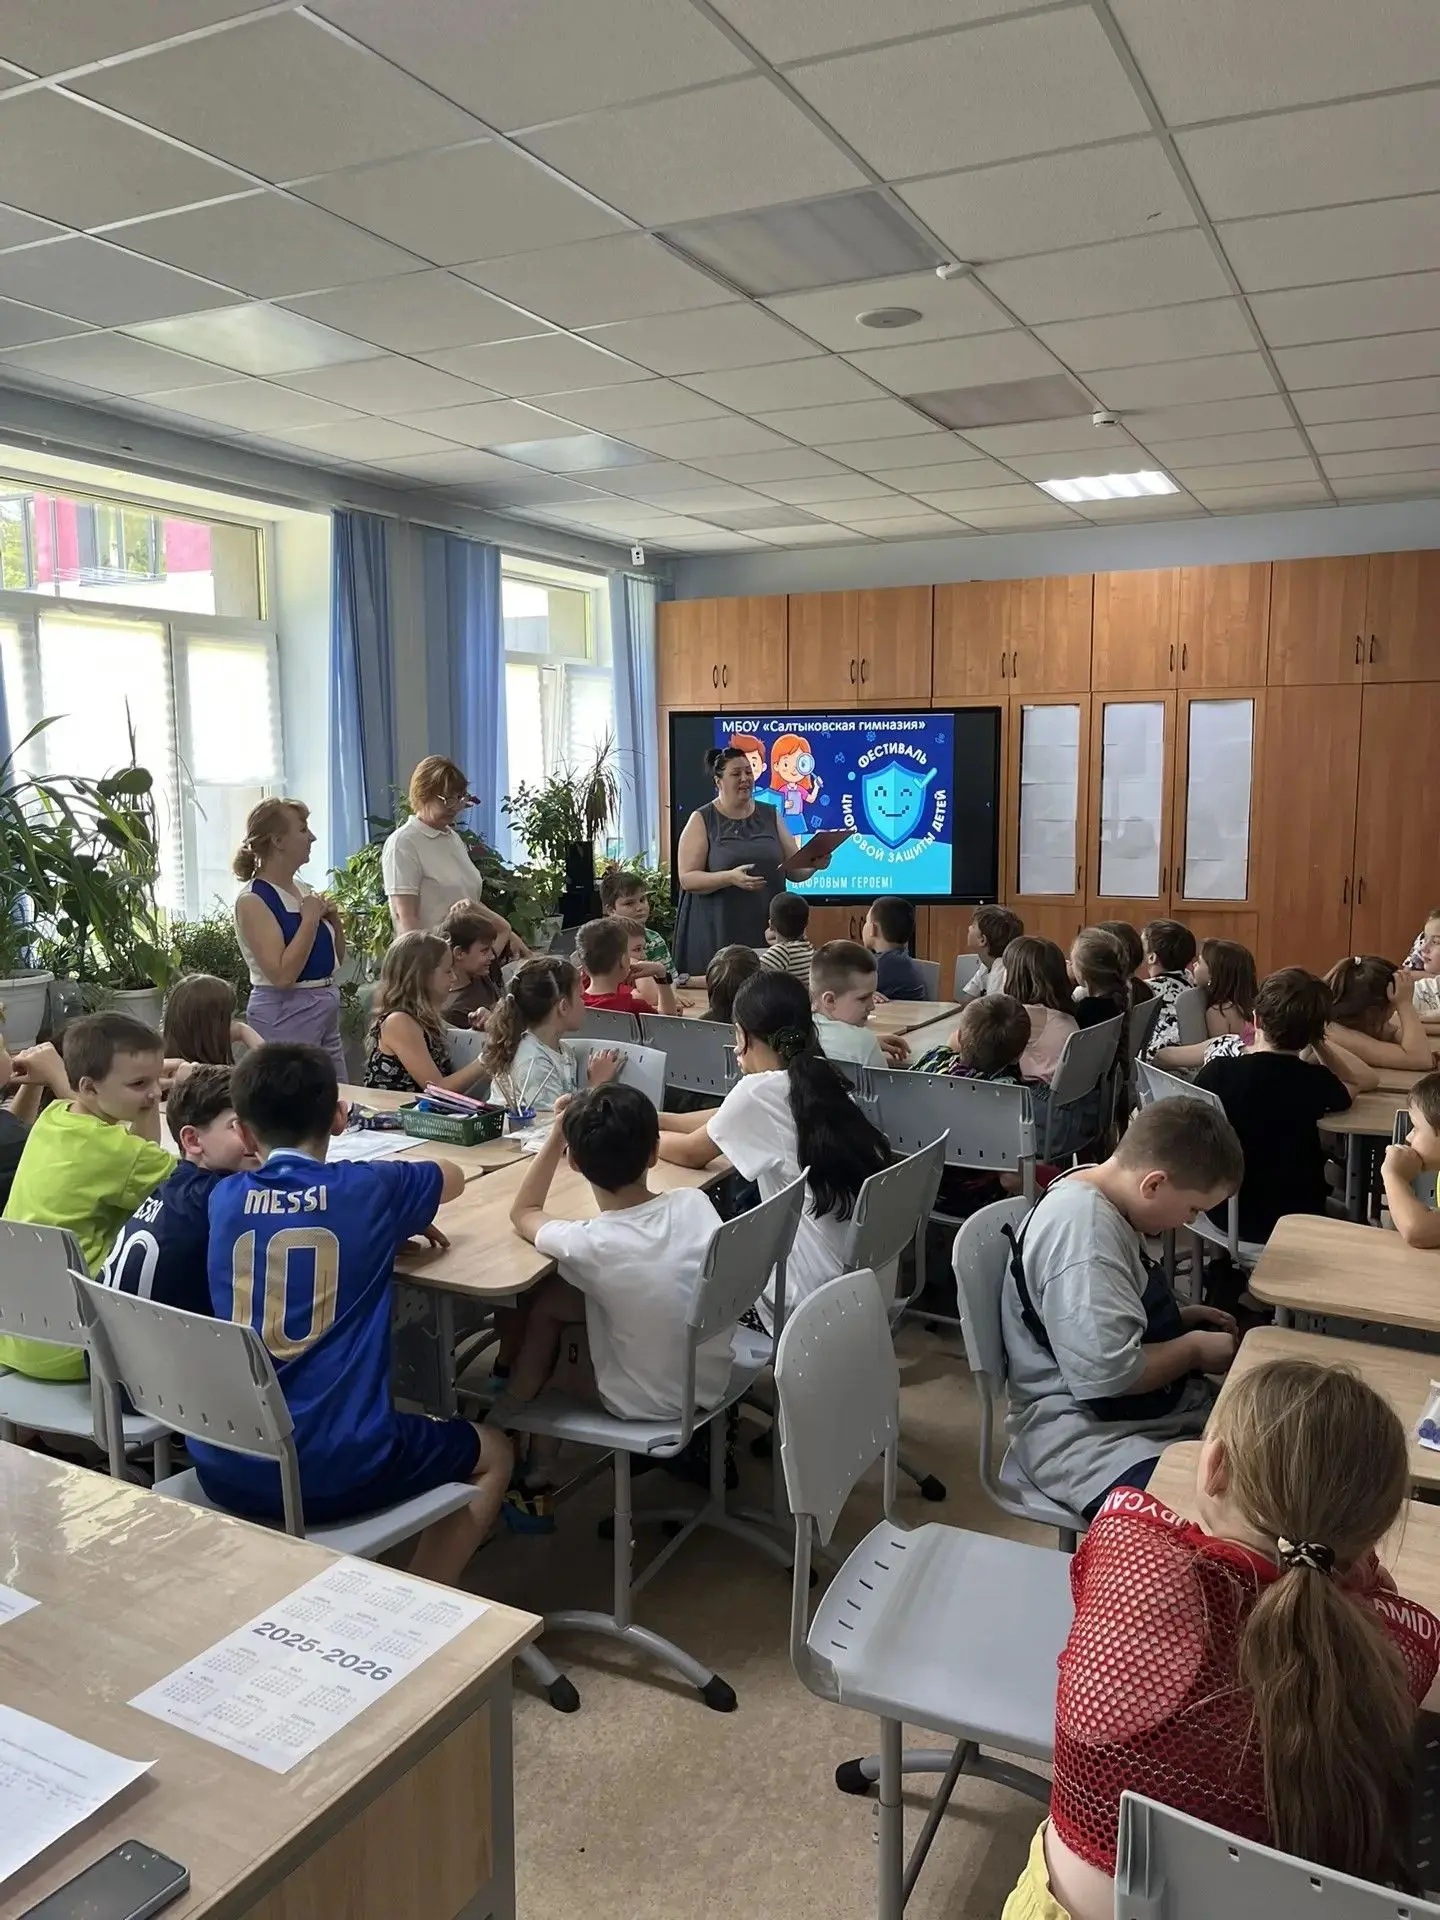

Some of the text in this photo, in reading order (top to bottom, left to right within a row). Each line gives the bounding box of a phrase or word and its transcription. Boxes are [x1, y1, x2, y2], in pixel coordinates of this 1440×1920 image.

[722, 720, 926, 732] МБОУ «Салтыковская гимназия»
[857, 742, 927, 769] ФЕСТИВАЛЬ
[887, 832, 936, 863] ЗАЩИТЫ
[931, 789, 947, 833] ДЕТЕЙ
[851, 876, 893, 889] ГЕРОЕМ!
[244, 1185, 327, 1215] MESSI
[232, 1226, 340, 1361] 10
[1373, 1597, 1440, 1650] AMIDY
[252, 1622, 392, 1680] 2025-2026
